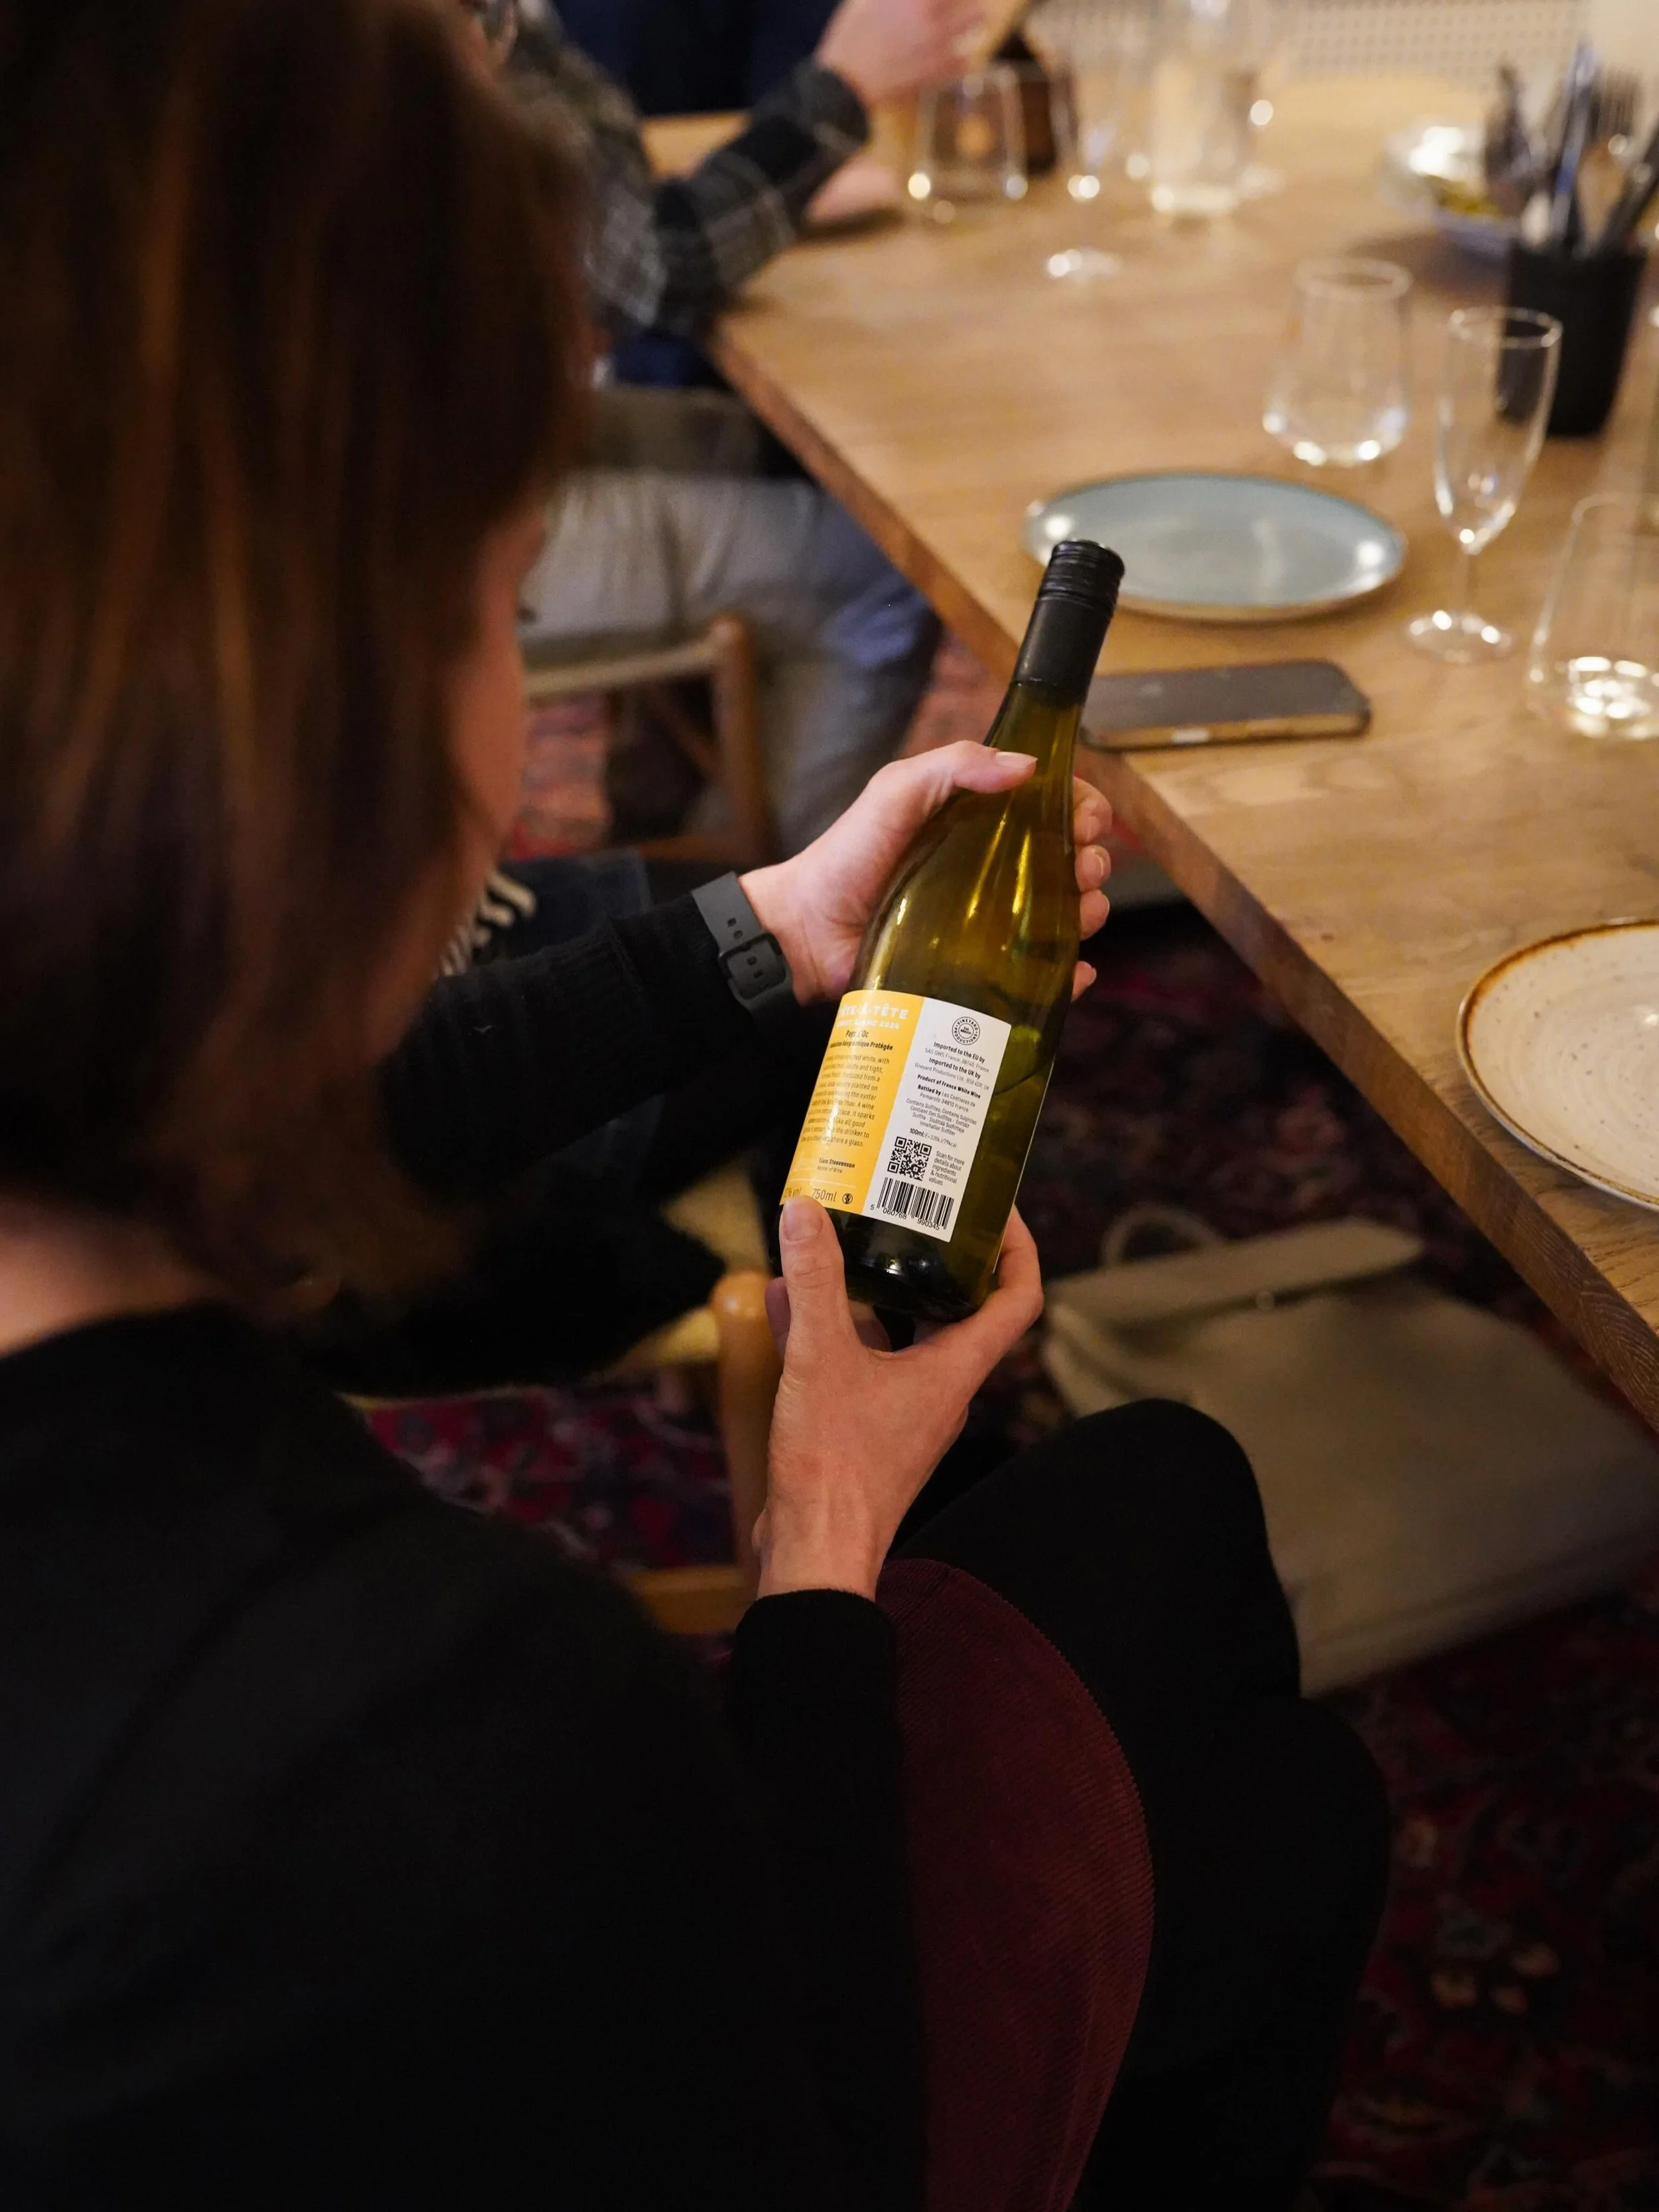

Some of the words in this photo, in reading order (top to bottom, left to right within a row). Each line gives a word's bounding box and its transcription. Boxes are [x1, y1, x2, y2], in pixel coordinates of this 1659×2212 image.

[957, 1019, 978, 1030] VINEYARD
[870, 1041, 893, 1051] Protégée
[934, 1041, 957, 1053] Imported
[928, 1057, 952, 1069] Imported
[917, 1074, 936, 1083] Product
[942, 1081, 957, 1090] France
[958, 1086, 970, 1094] White
[918, 1084, 934, 1093] Bottled
[906, 1098, 924, 1108] Contains
[942, 1108, 960, 1118] Contains
[857, 1111, 875, 1120] sparks
[844, 1128, 863, 1137] drinker
[829, 1159, 855, 1168] Steevenson
[934, 1157, 949, 1167] details
[949, 1161, 962, 1171] about
[936, 1150, 948, 1159] Scan
[954, 1157, 965, 1166] more
[932, 1165, 956, 1177] ingredients
[935, 1171, 958, 1184] nutritional
[812, 1188, 837, 1202] 750ml
[883, 1208, 907, 1220] 060768
[917, 1218, 940, 1230] 990345
